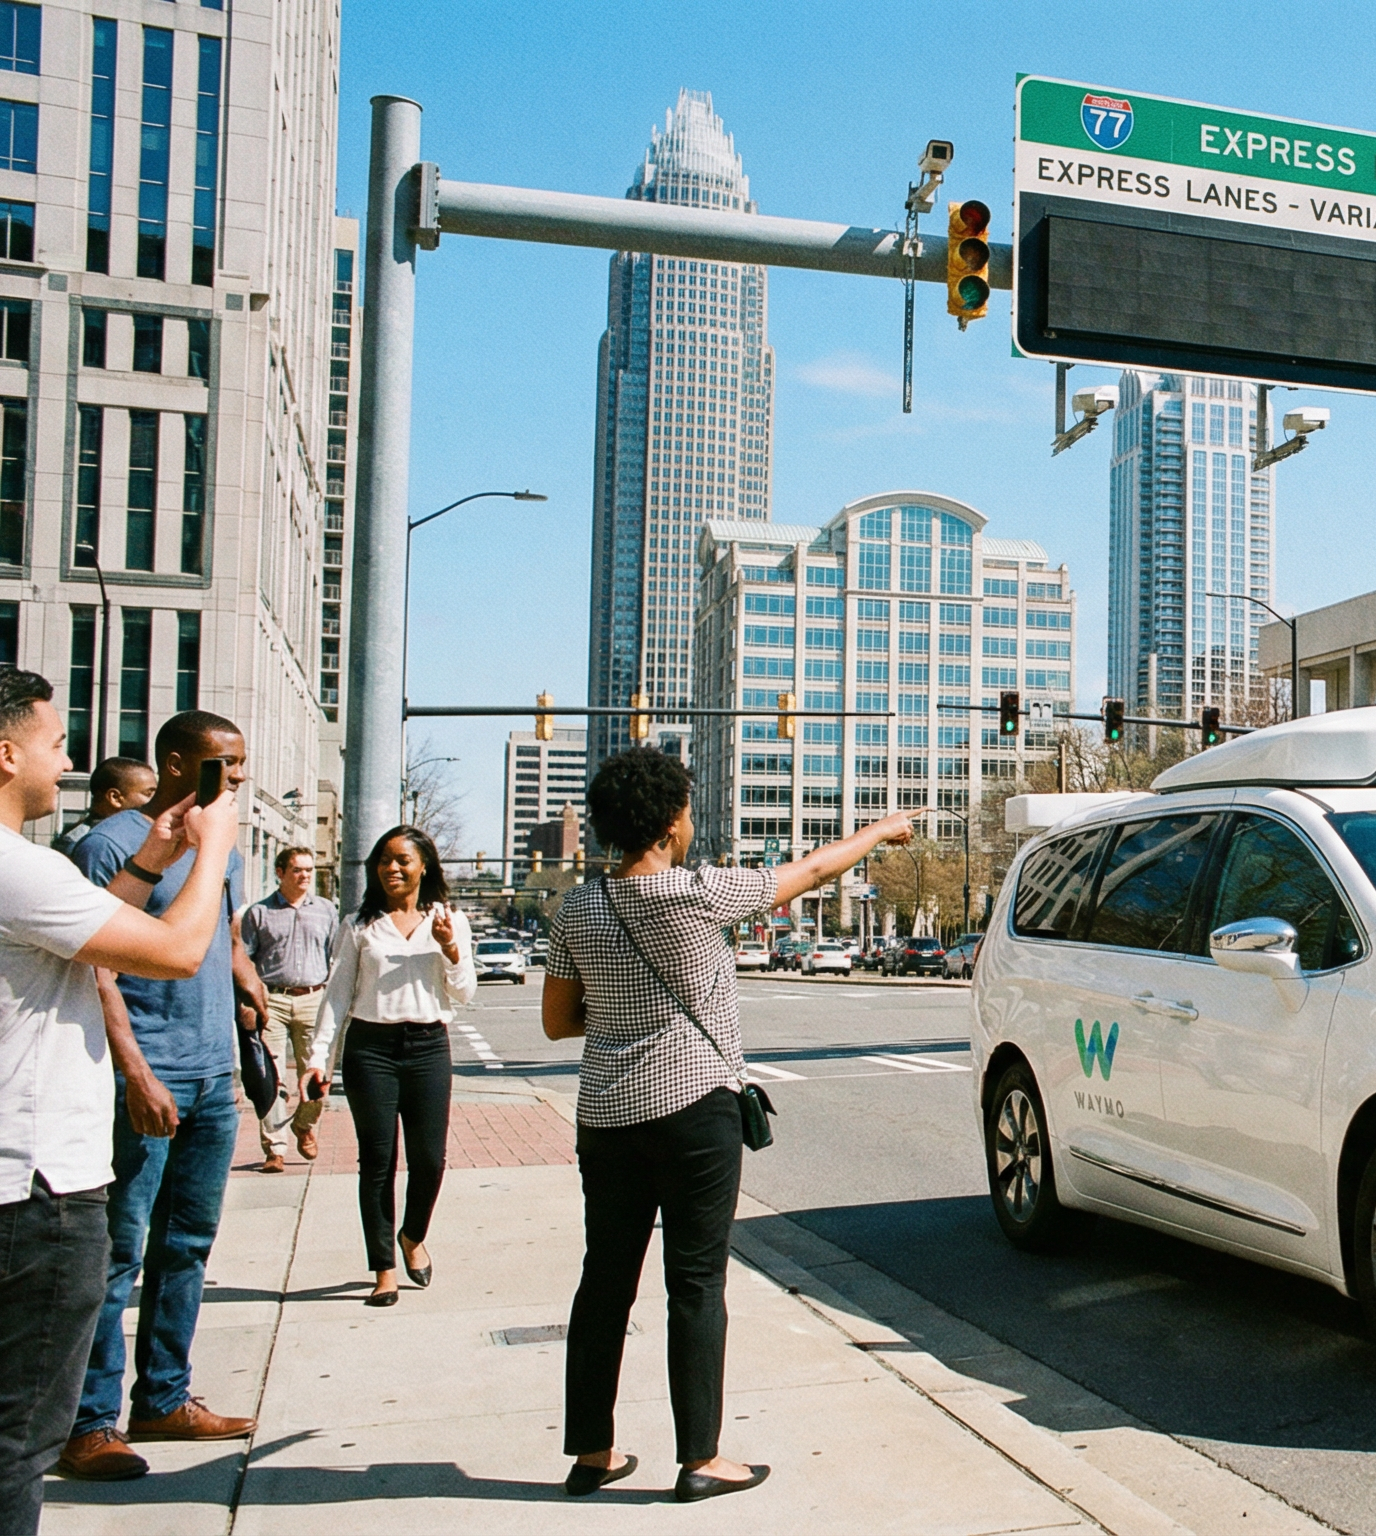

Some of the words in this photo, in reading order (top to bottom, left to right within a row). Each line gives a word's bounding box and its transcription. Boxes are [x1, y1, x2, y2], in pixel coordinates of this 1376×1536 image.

[1090, 108, 1126, 138] 77
[1201, 124, 1356, 175] EXPRESS
[1038, 157, 1170, 198] EXPRESS
[1186, 179, 1278, 213] LANES
[1074, 1018, 1120, 1082] W
[1074, 1090, 1124, 1119] WAYMO
